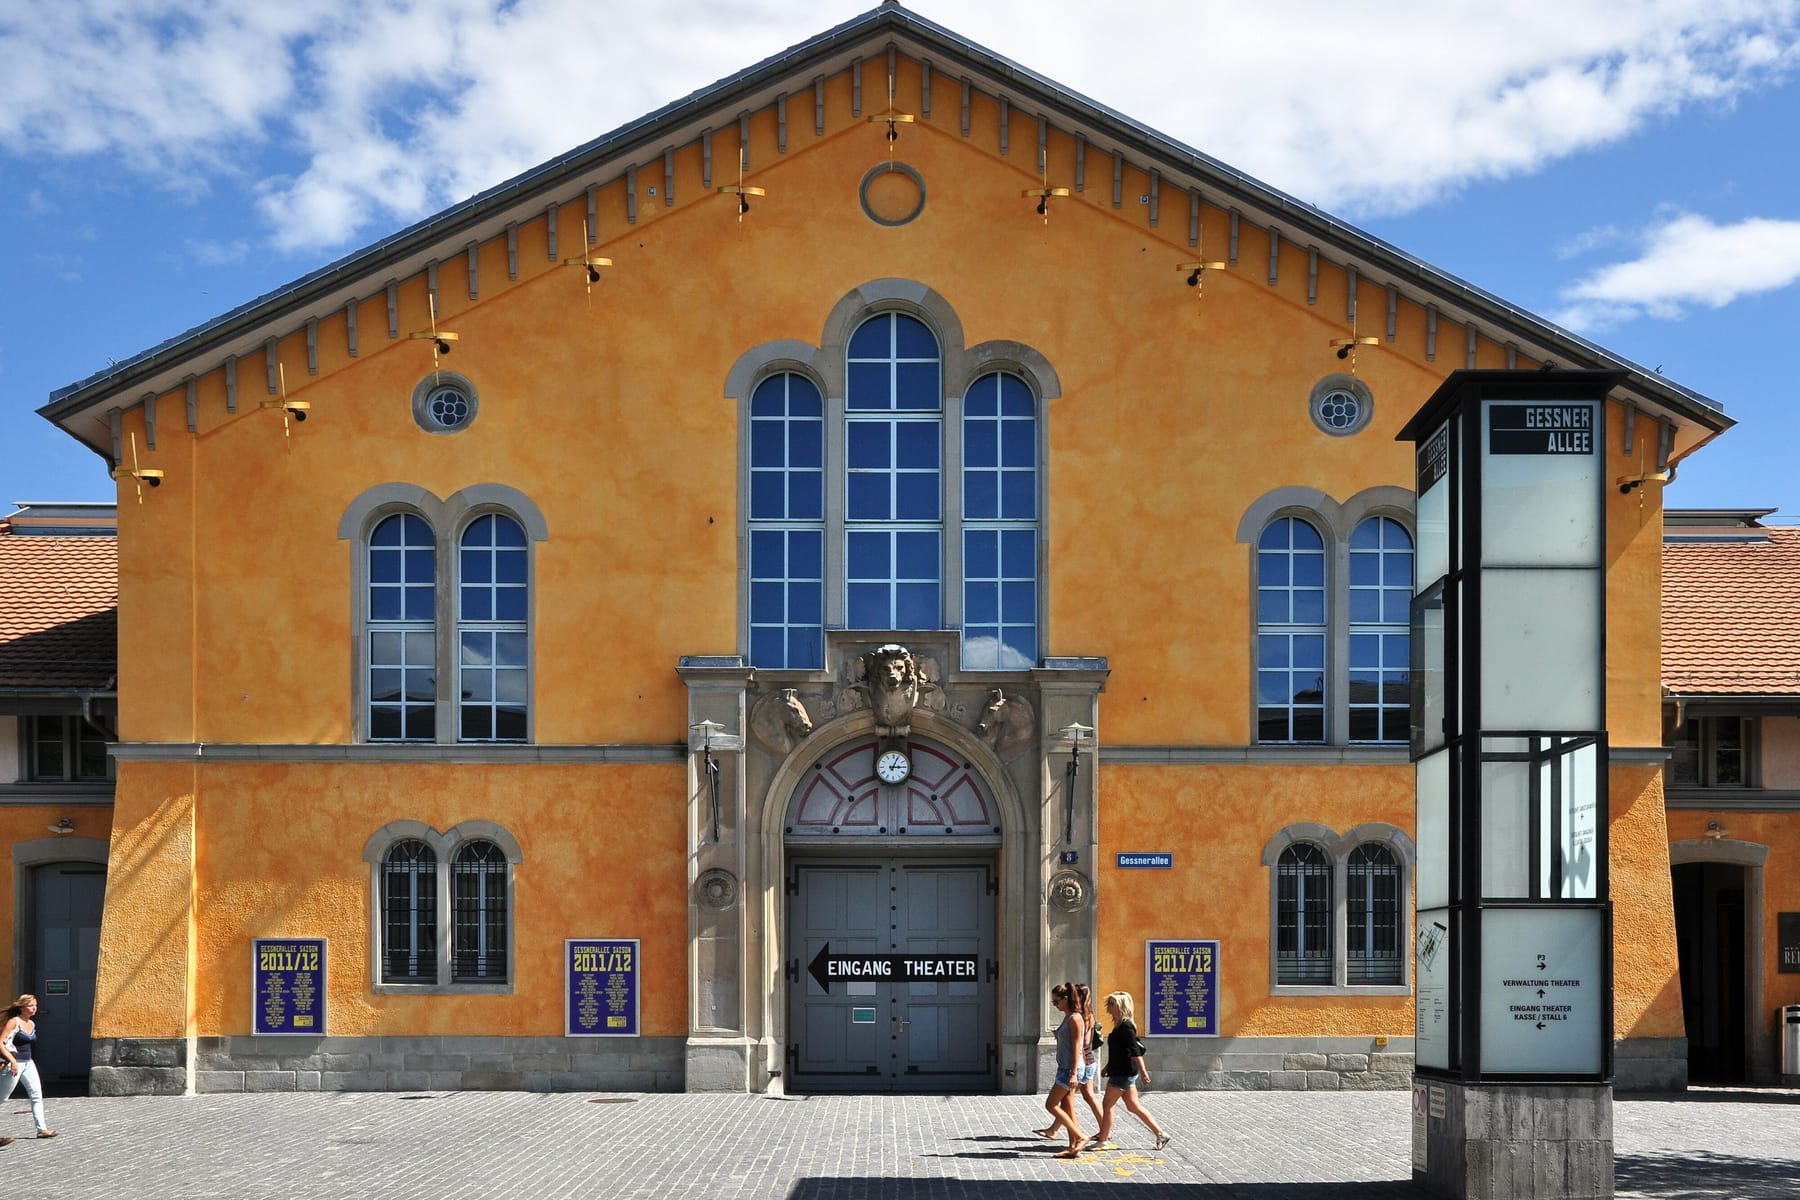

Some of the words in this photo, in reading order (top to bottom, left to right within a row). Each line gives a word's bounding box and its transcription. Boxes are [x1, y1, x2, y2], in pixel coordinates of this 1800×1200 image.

[1526, 408, 1590, 428] GESSNER
[1427, 429, 1447, 465] GESSNER
[1547, 432, 1590, 452] ALLEE
[1433, 452, 1447, 481] ALLEE
[1120, 856, 1169, 865] Gessnerallee
[299, 945, 318, 953] SAISON
[613, 946, 631, 954] SAISON
[1193, 947, 1212, 955] SAISON
[260, 952, 318, 971] 2011/12
[574, 953, 632, 972] 2011/12
[828, 960, 892, 976] EINGANG
[903, 960, 976, 976] THEATER
[1154, 954, 1212, 973] 2011/12
